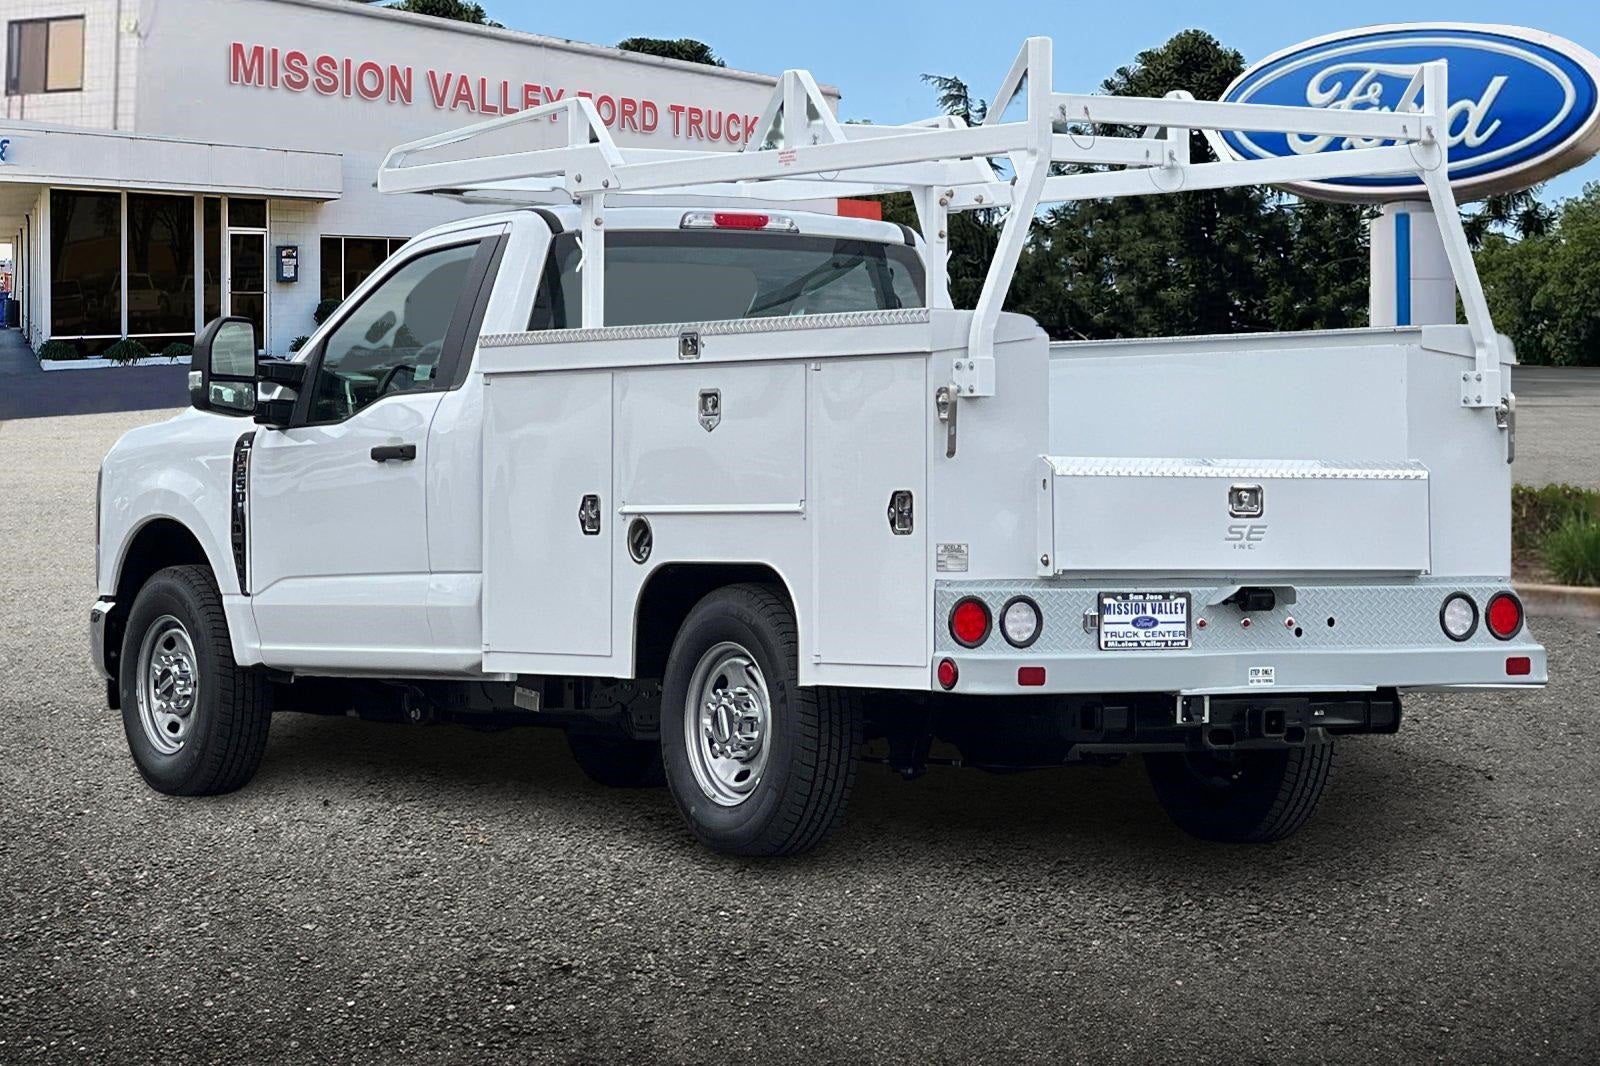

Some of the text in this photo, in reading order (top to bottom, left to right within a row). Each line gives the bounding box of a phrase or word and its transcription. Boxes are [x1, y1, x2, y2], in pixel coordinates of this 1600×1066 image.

[229, 41, 760, 145] MISSION VALLEY ORD TRUCK
[1286, 59, 1508, 155] Fd
[1225, 524, 1268, 541] SE
[1103, 602, 1185, 615] MISSION VALLEY
[1135, 618, 1154, 628] Ford
[1140, 640, 1166, 648] Valley
